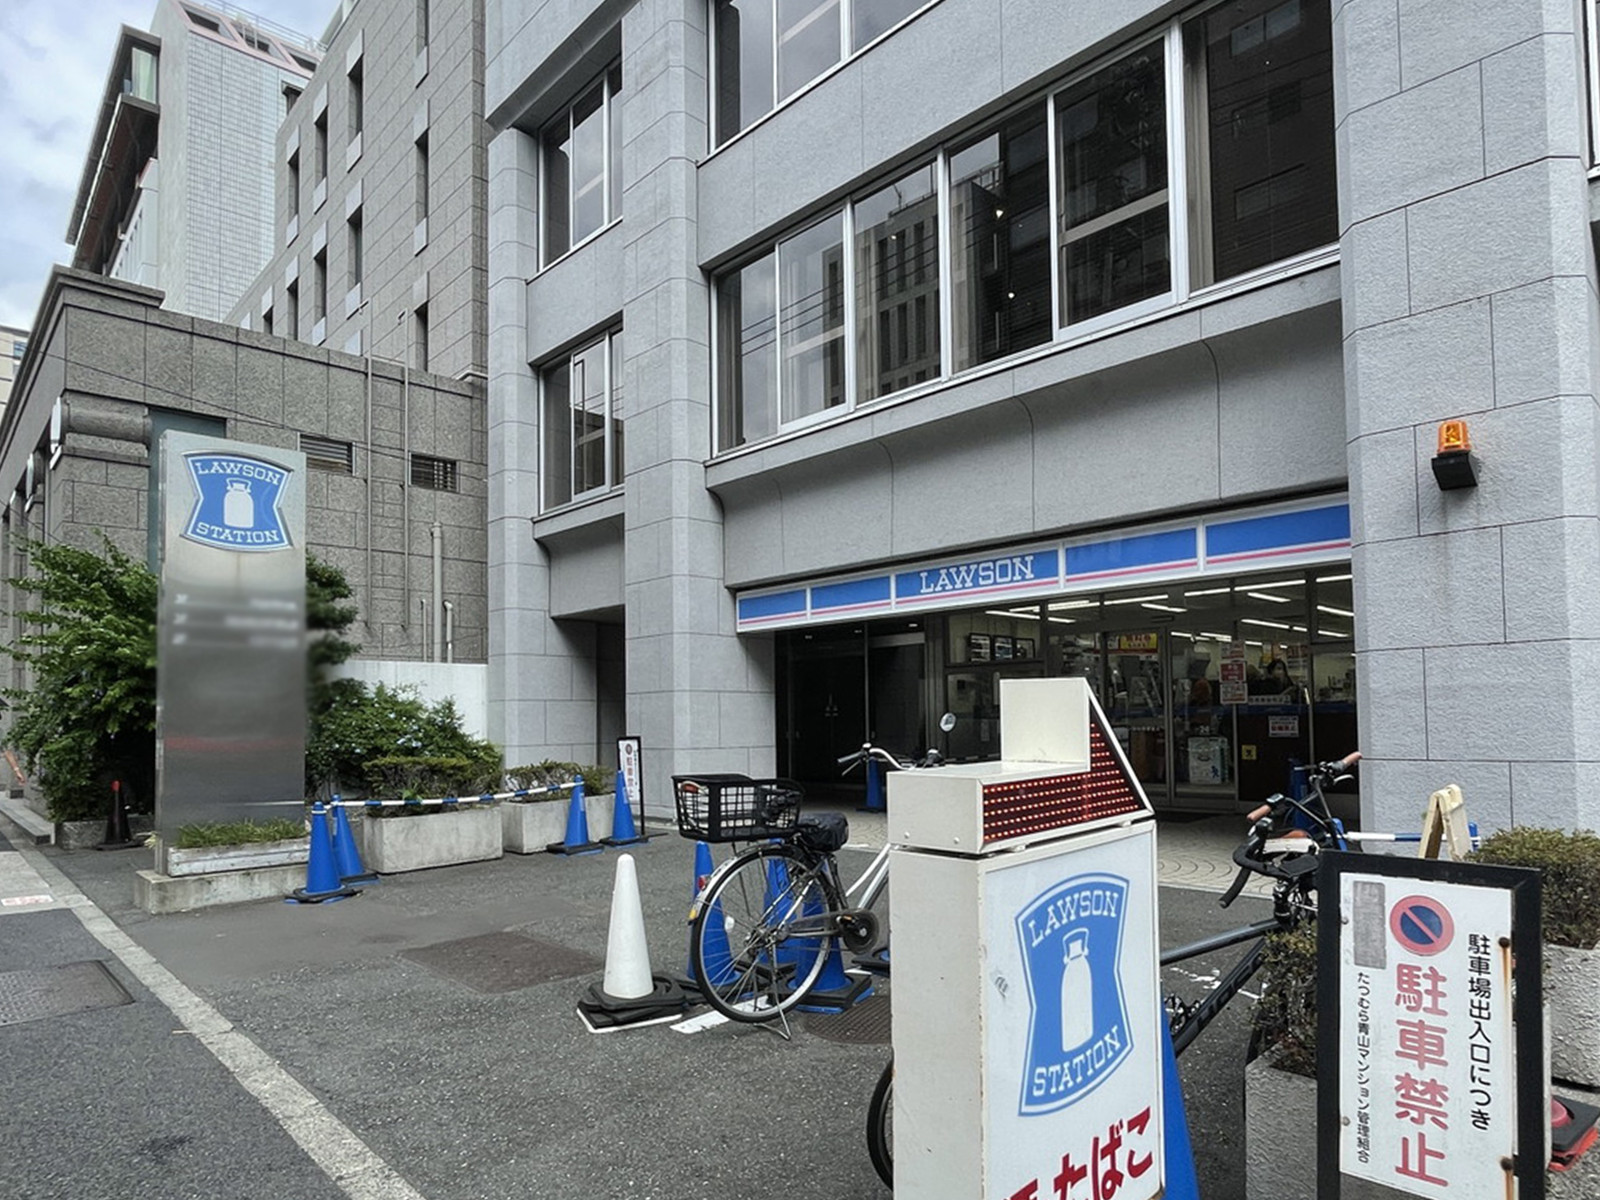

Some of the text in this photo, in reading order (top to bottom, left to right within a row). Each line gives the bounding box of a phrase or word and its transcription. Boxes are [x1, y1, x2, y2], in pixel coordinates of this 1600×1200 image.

[195, 461, 281, 485] LAWSON
[196, 521, 280, 543] STATION
[919, 555, 1035, 593] LAWSON
[1028, 889, 1119, 948] LAWSON
[1032, 1024, 1121, 1097] STATION
[1467, 933, 1492, 1131] 駐車場出入口につき
[1395, 963, 1449, 1187] 駐車禁止
